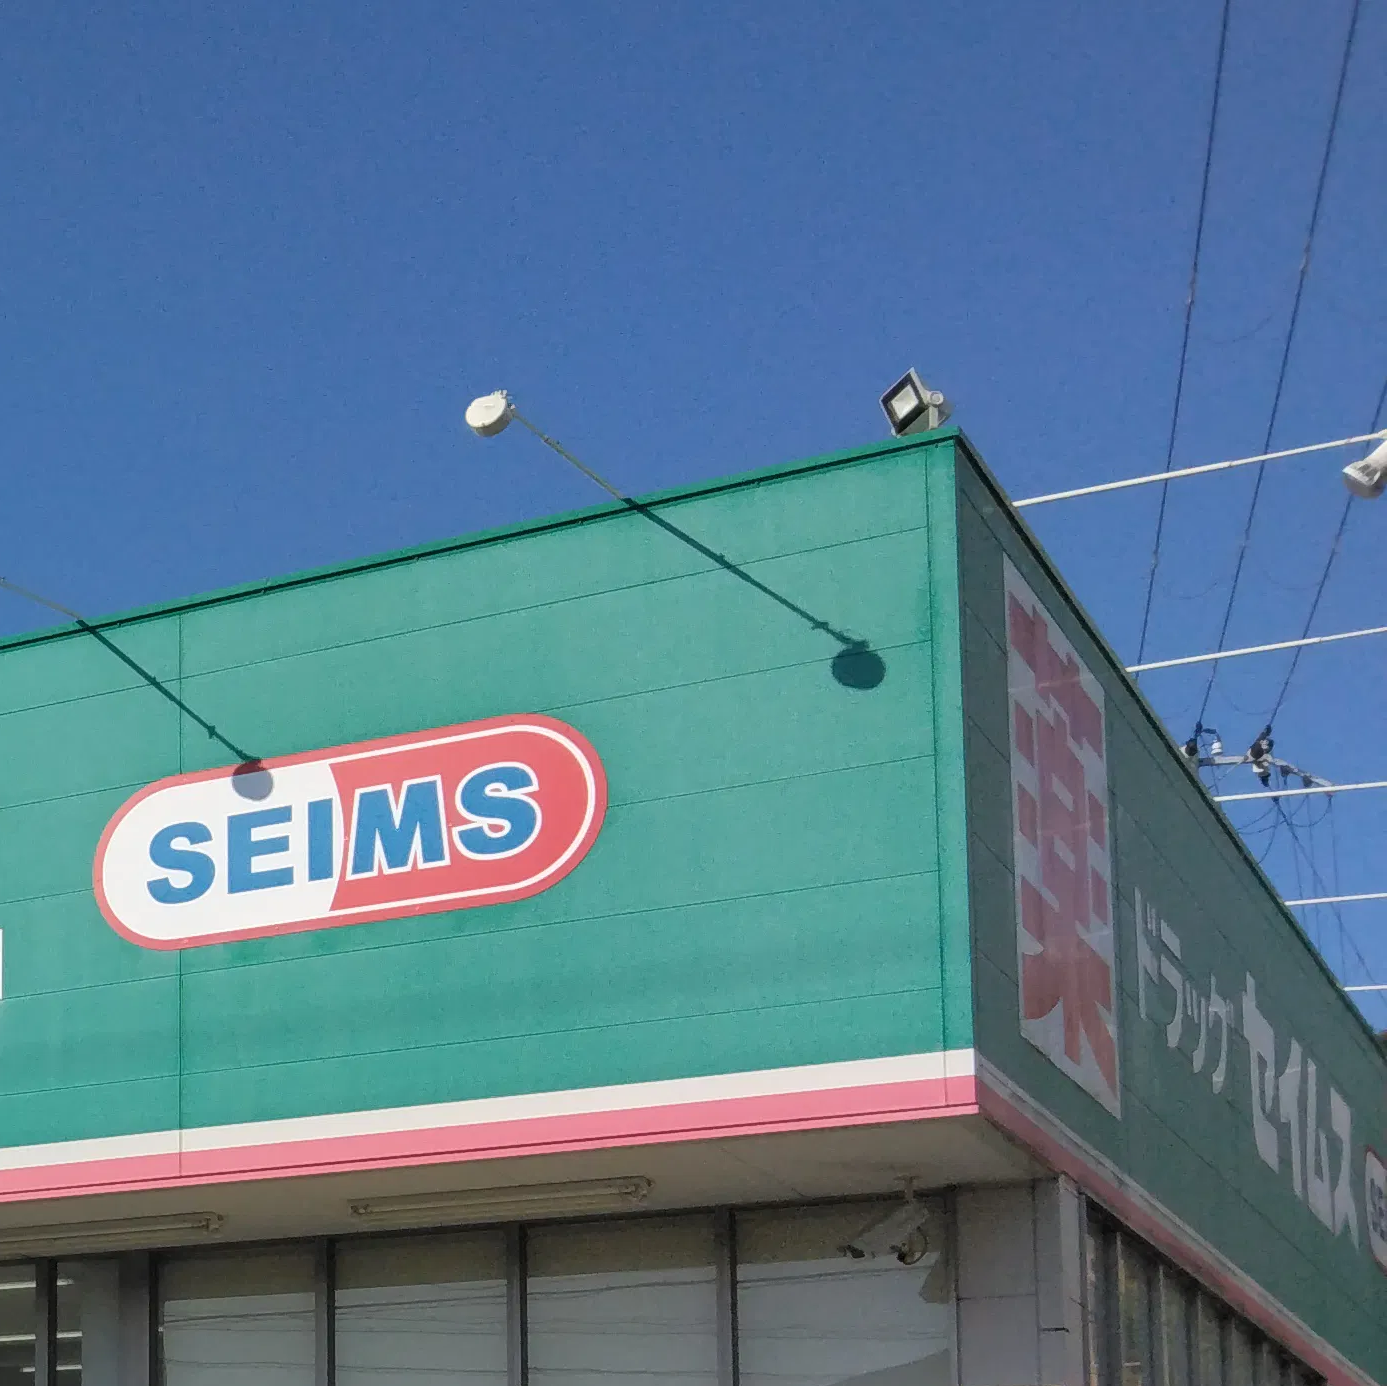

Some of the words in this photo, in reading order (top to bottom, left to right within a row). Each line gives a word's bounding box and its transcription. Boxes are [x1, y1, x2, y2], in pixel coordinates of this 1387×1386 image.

[145, 761, 543, 905] SEIMS
[1008, 590, 1117, 1101] 薬
[1134, 886, 1235, 1095] ドラッグ
[1241, 970, 1360, 1251] セイムス
